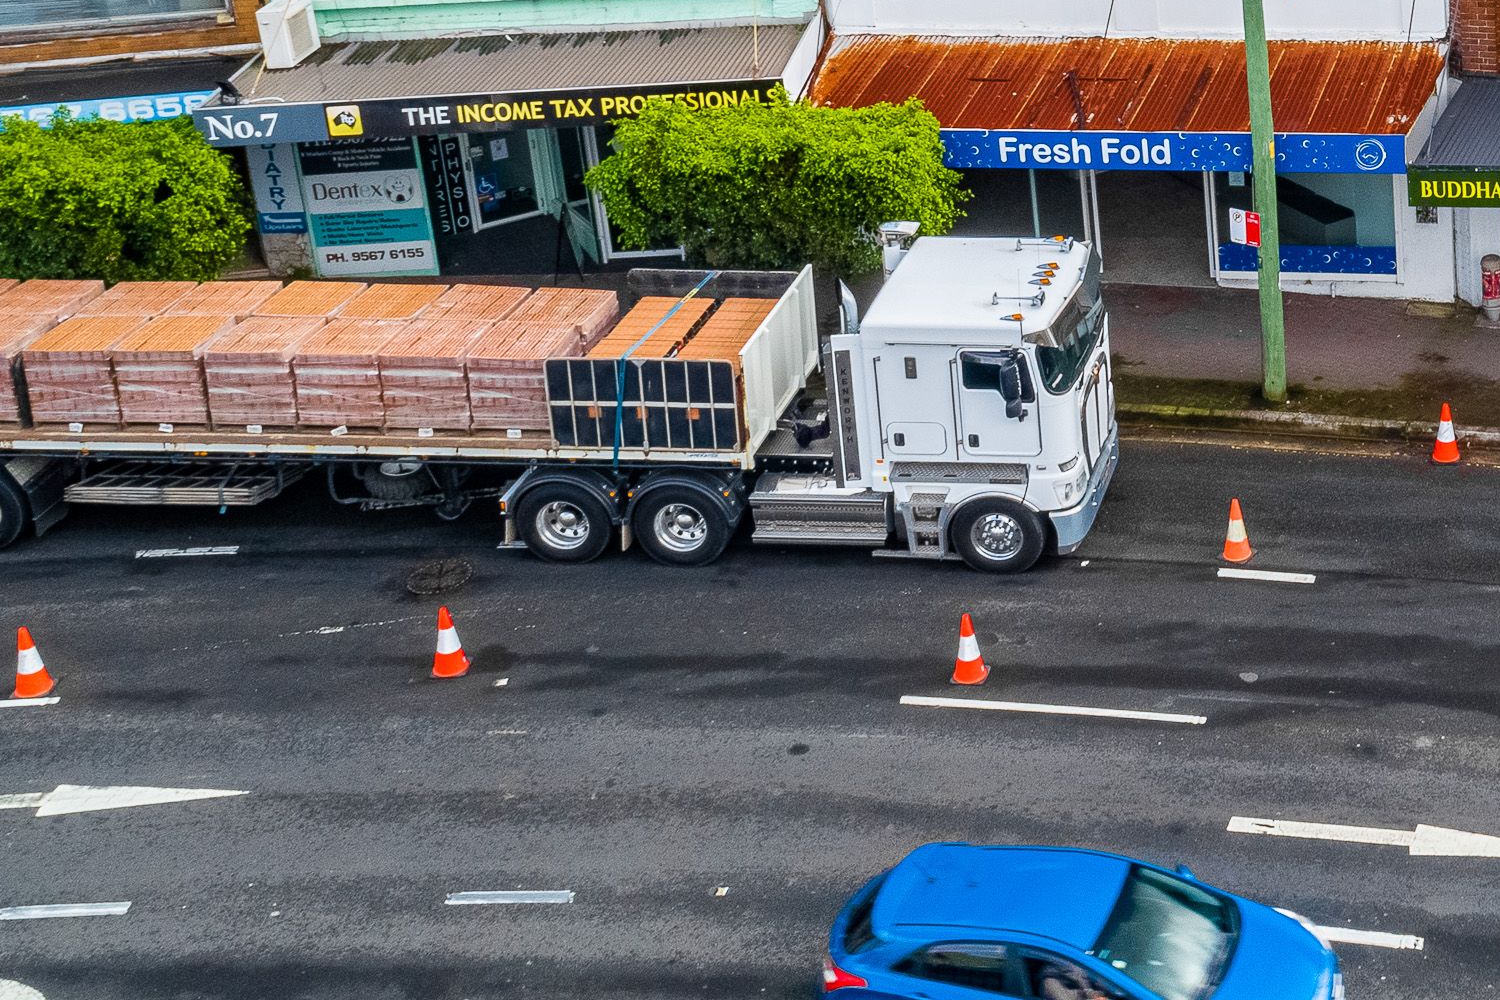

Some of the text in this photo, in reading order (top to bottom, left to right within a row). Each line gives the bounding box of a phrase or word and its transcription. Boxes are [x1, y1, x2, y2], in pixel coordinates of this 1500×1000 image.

[204, 112, 278, 141] No.7
[402, 107, 451, 127] THE
[456, 103, 545, 123] INCOME
[549, 99, 595, 119] TAX
[998, 136, 1172, 165] Fresh Fold
[312, 182, 383, 201] Dentex
[445, 143, 470, 228] PHYSIO
[326, 248, 424, 263] PH. 9567 6155
